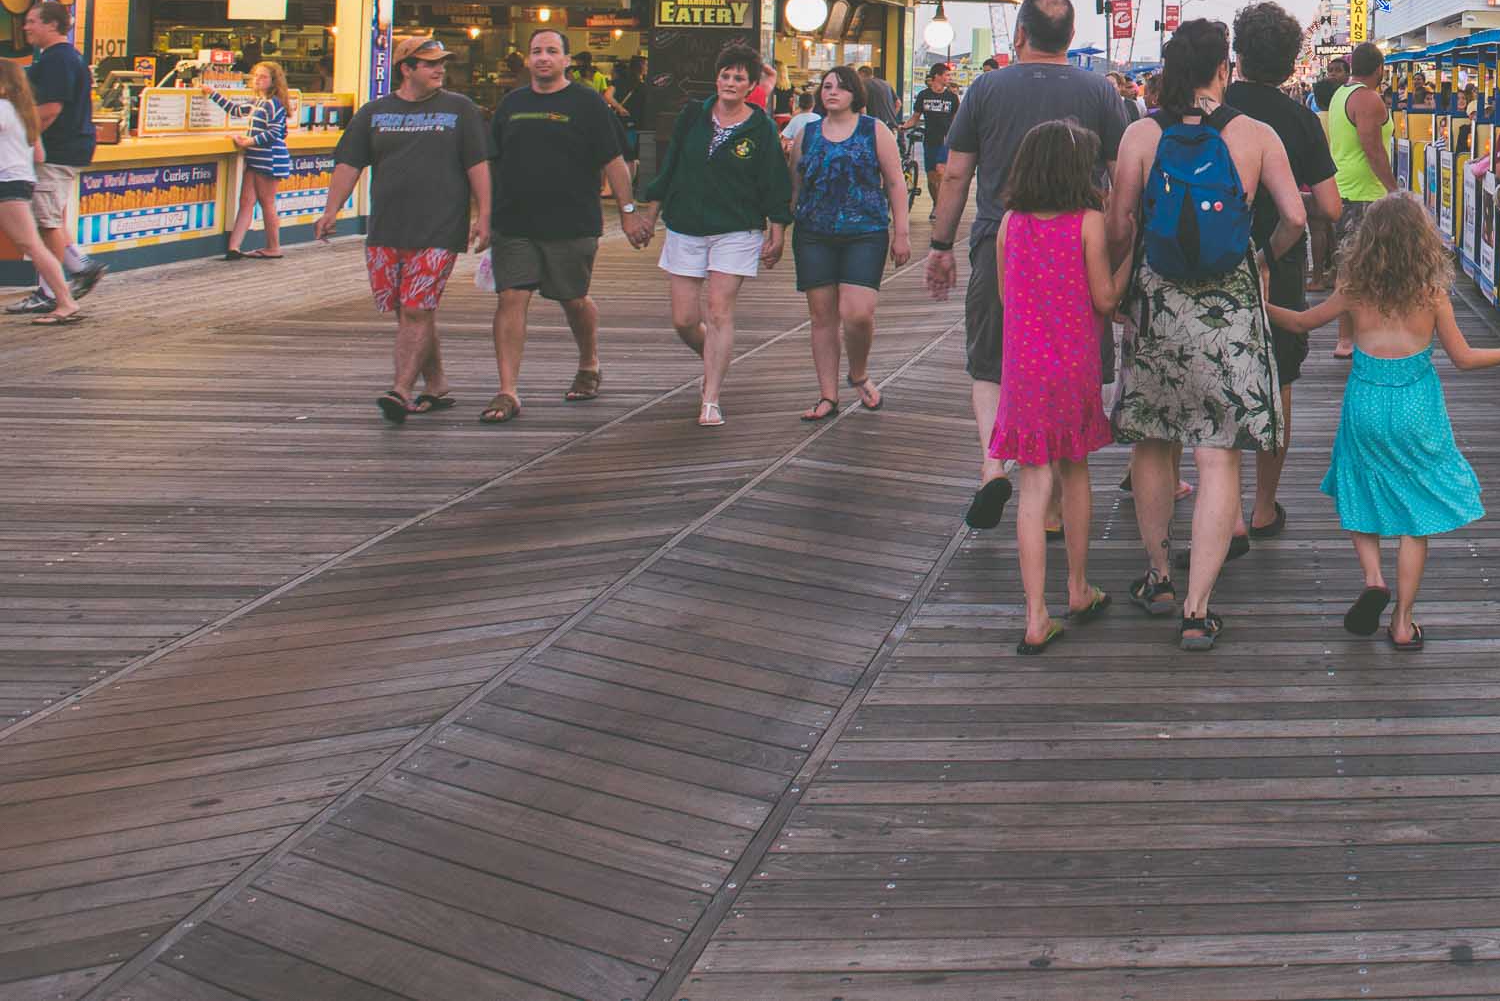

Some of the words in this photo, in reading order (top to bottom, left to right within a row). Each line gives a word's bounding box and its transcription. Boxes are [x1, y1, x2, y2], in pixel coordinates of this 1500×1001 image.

[660, 0, 749, 24] EATERY
[95, 39, 126, 56] HOT
[376, 52, 385, 99] FRI
[163, 167, 190, 183] Curley
[192, 166, 211, 180] Fries
